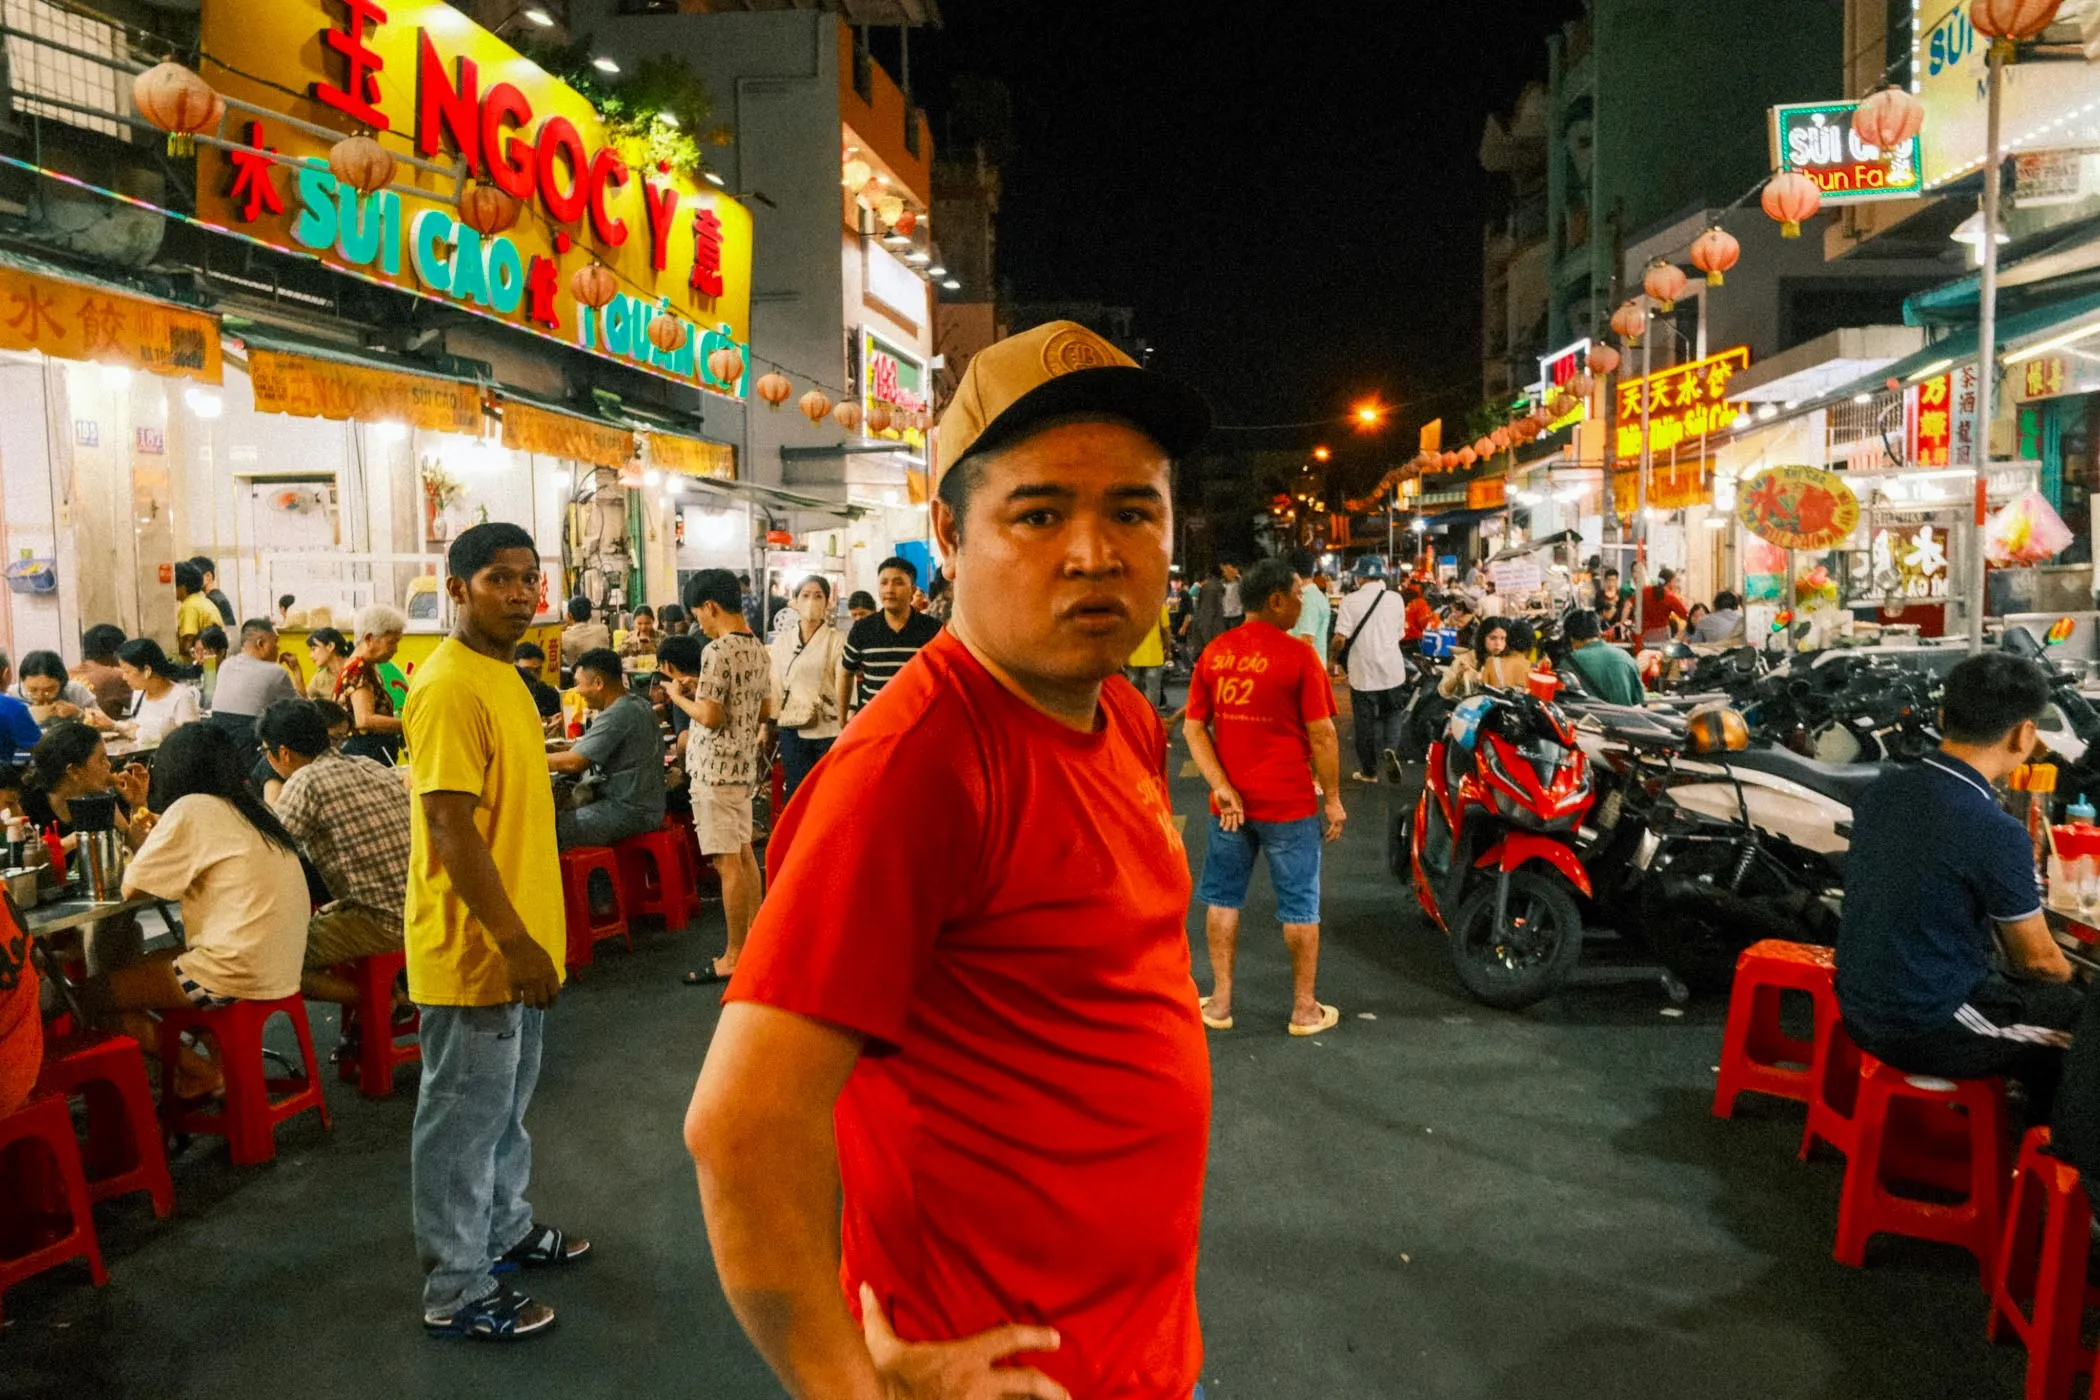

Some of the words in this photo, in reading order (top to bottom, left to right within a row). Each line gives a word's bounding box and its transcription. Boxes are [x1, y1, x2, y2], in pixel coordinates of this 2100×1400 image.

[414, 27, 629, 254] NGỌC
[1789, 113, 1842, 166] SỦI
[231, 120, 284, 222] 水
[1855, 165, 1884, 188] Fa
[1216, 676, 1255, 706] 162
